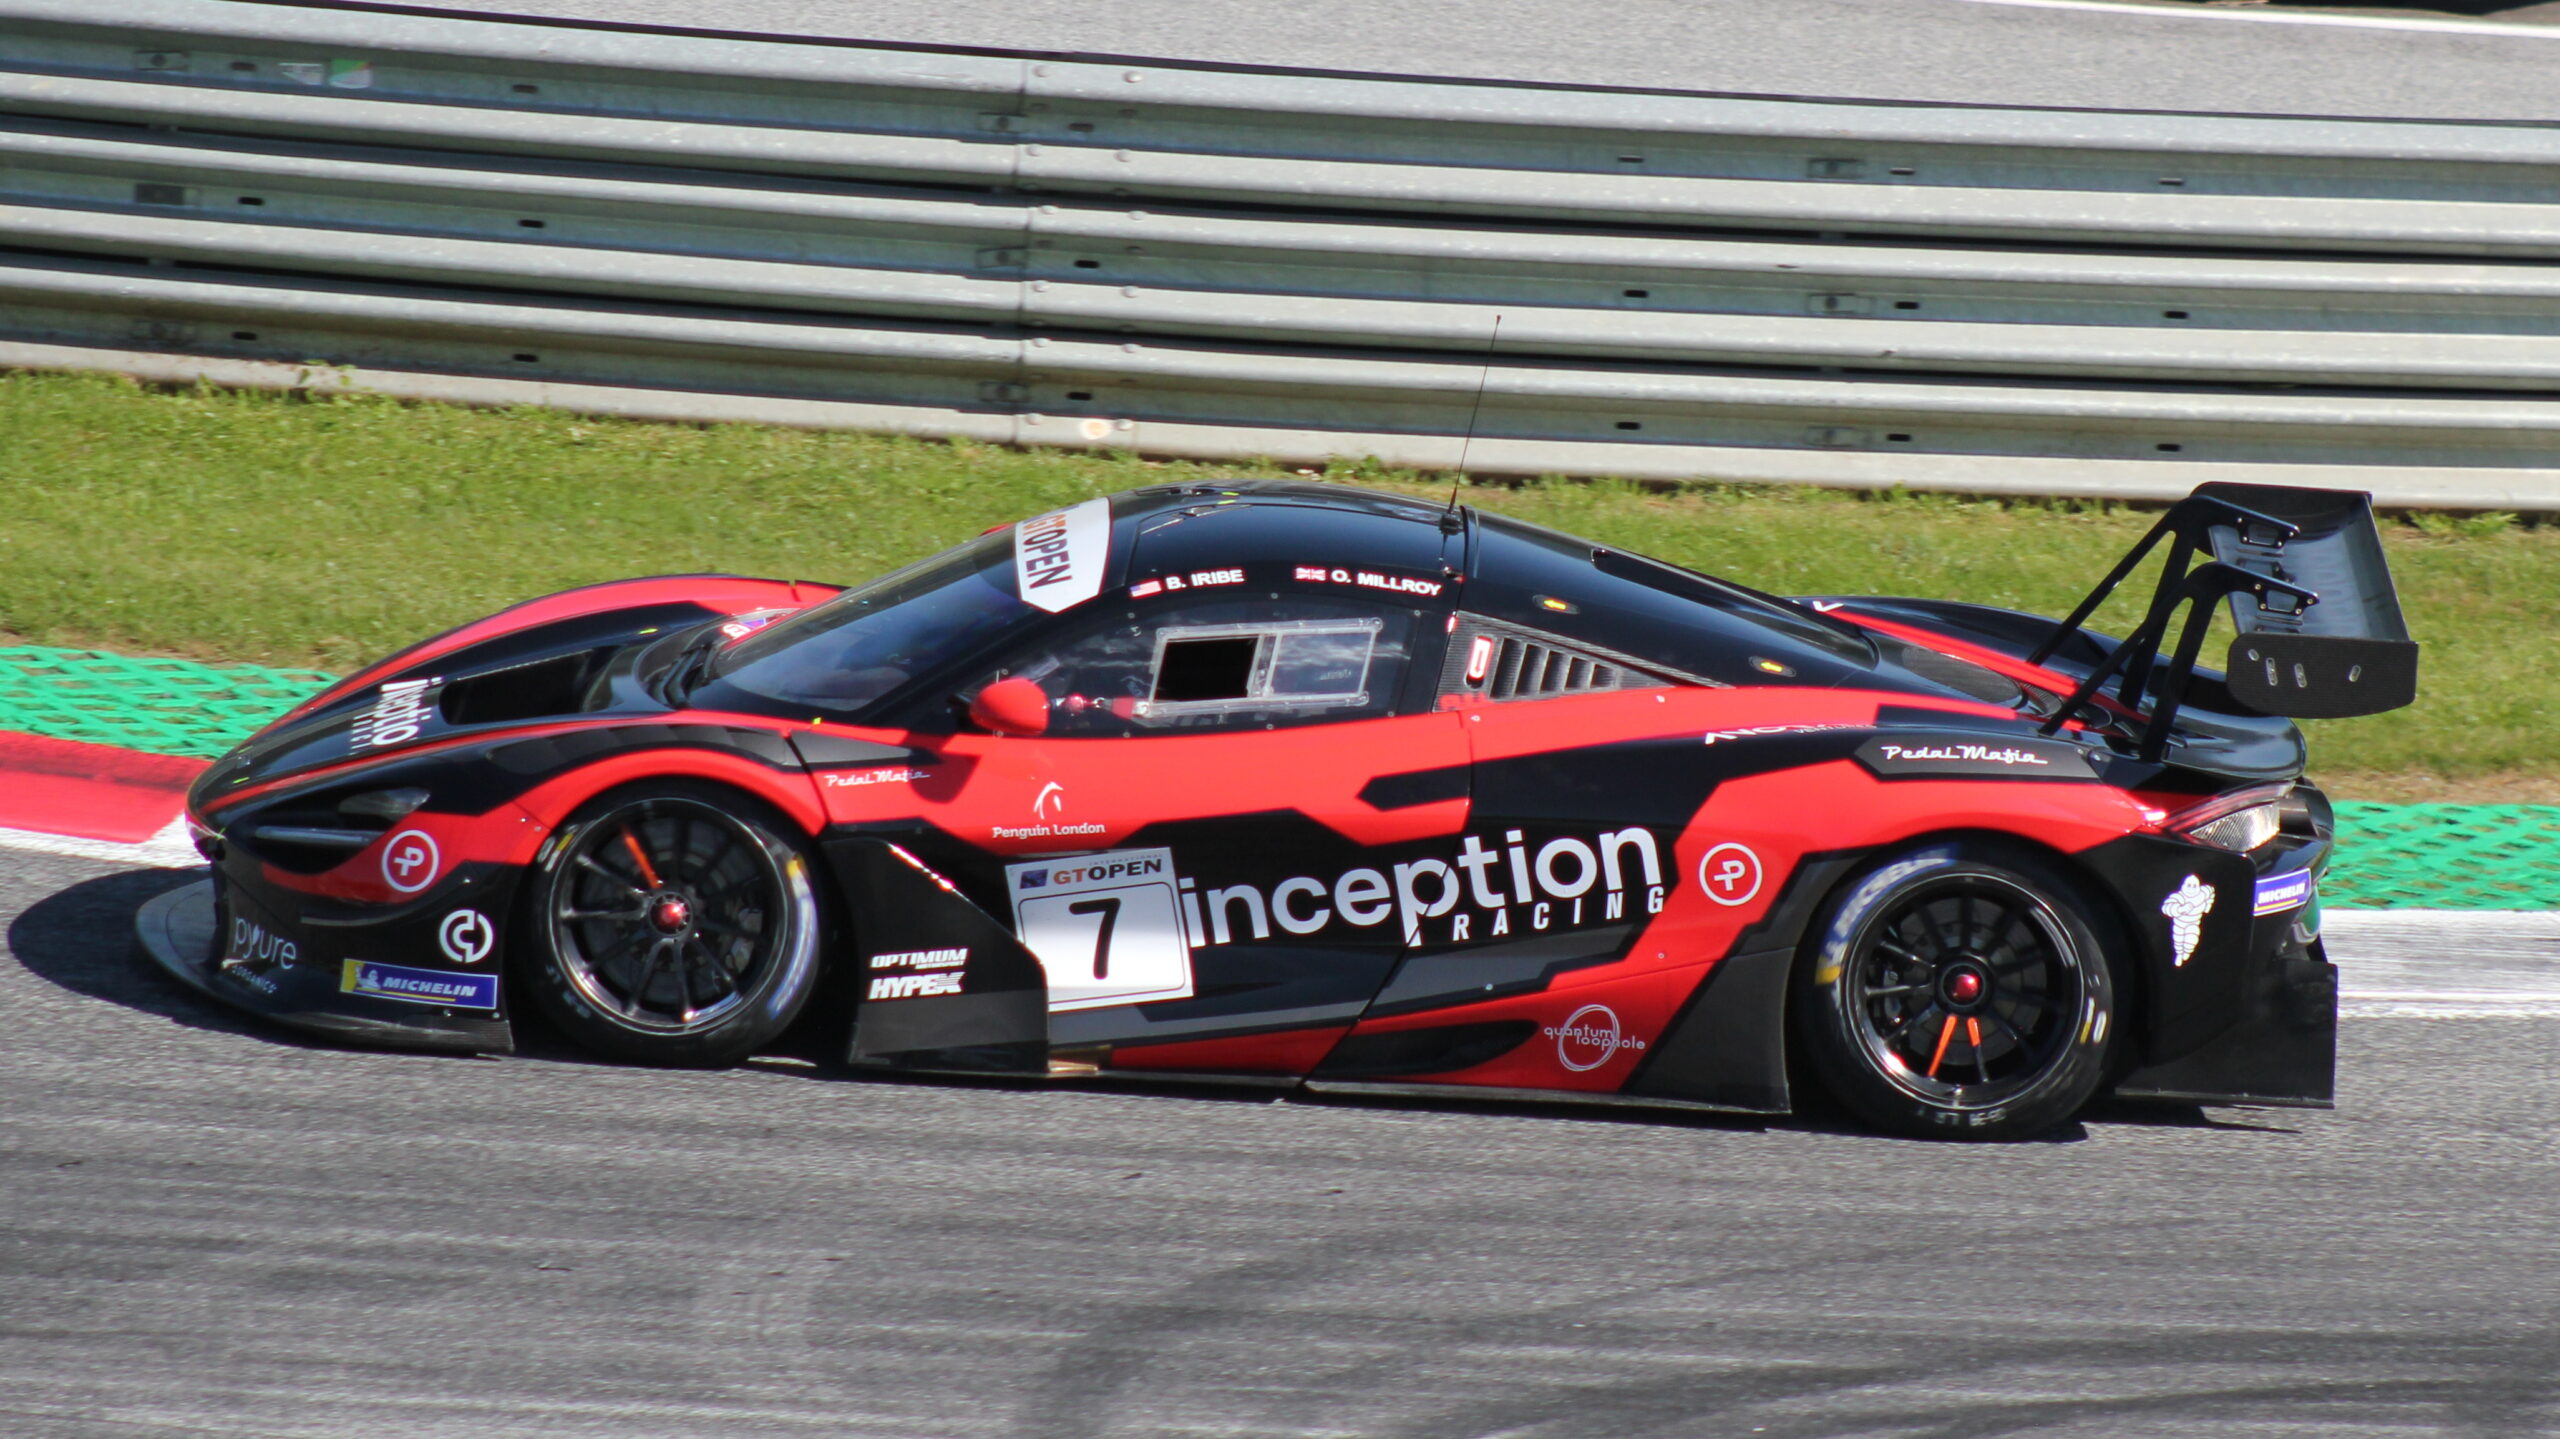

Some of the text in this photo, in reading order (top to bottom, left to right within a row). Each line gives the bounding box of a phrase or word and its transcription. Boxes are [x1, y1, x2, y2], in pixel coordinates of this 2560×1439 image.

[1165, 569, 1245, 590] B. IRIBE
[1331, 569, 1442, 597] O. MILLROY
[1880, 745, 2049, 765] Pedal Mafia
[824, 769, 931, 788] Pedal Mafia
[991, 822, 1106, 840] Penguin London
[1053, 858, 1162, 885] GTOPEN
[1178, 826, 1662, 948] inception
[2257, 882, 2306, 904] MICHELIN
[1452, 886, 1664, 942] RACING
[233, 916, 297, 970] pyure
[1068, 897, 1121, 980] 7
[870, 948, 969, 968] OPTIMUM
[382, 976, 478, 997] MICHELIN
[1543, 1023, 1616, 1040] quantum
[1575, 1032, 1646, 1051] loophole
